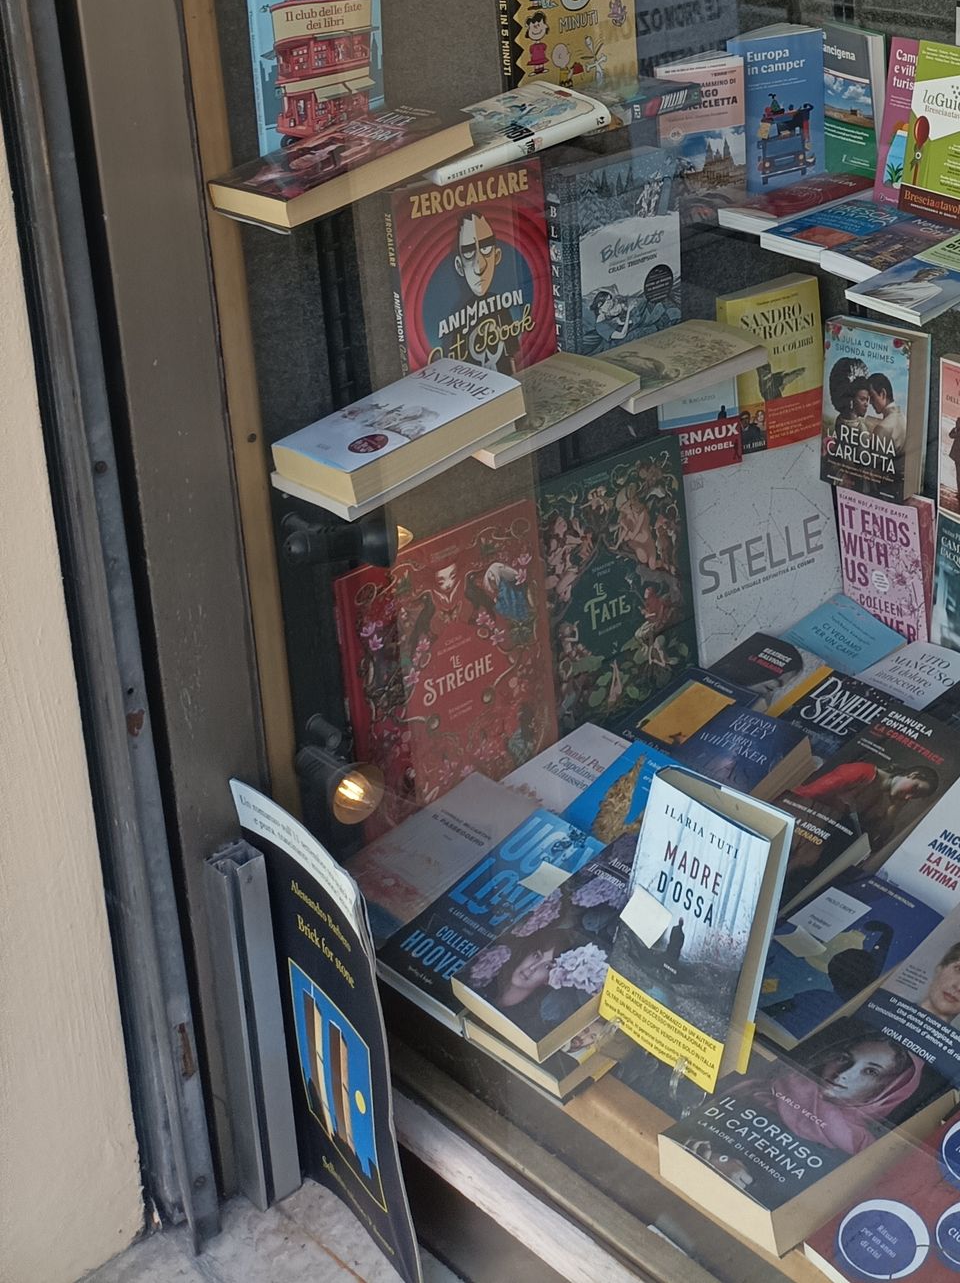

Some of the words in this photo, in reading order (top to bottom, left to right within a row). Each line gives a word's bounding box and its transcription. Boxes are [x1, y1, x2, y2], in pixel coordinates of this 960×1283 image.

[285, 11, 294, 21] Il
[297, 9, 316, 21] club
[317, 6, 340, 17] delle
[342, 2, 362, 14] fate
[306, 19, 321, 29] dei
[323, 16, 344, 28] libri
[559, 10, 598, 34] MINUTI
[747, 47, 789, 62] Europa
[748, 63, 758, 74] in
[760, 58, 806, 75] camper
[410, 169, 528, 218] ZEROCALCARE
[600, 229, 664, 262] Blankets
[439, 289, 524, 338] ANIMATION
[827, 427, 837, 438] LA
[840, 423, 896, 456] REGINA
[827, 441, 895, 474] CARLOTTA
[840, 503, 855, 527] IT
[862, 510, 910, 548] ENDS
[700, 516, 823, 595] STELLE
[843, 531, 889, 567] WITH
[843, 558, 869, 585] US
[423, 654, 494, 706] STREGHE
[806, 676, 888, 725] DANIELLE
[665, 840, 723, 896] MADRE
[928, 852, 941, 865] LA
[919, 862, 959, 892] INTIMA
[657, 873, 714, 927] D'OSSA
[704, 1106, 723, 1121] DI
[718, 1116, 805, 1180] CATERINA
[719, 1097, 735, 1108] IL
[740, 1103, 823, 1168] SORRISO
